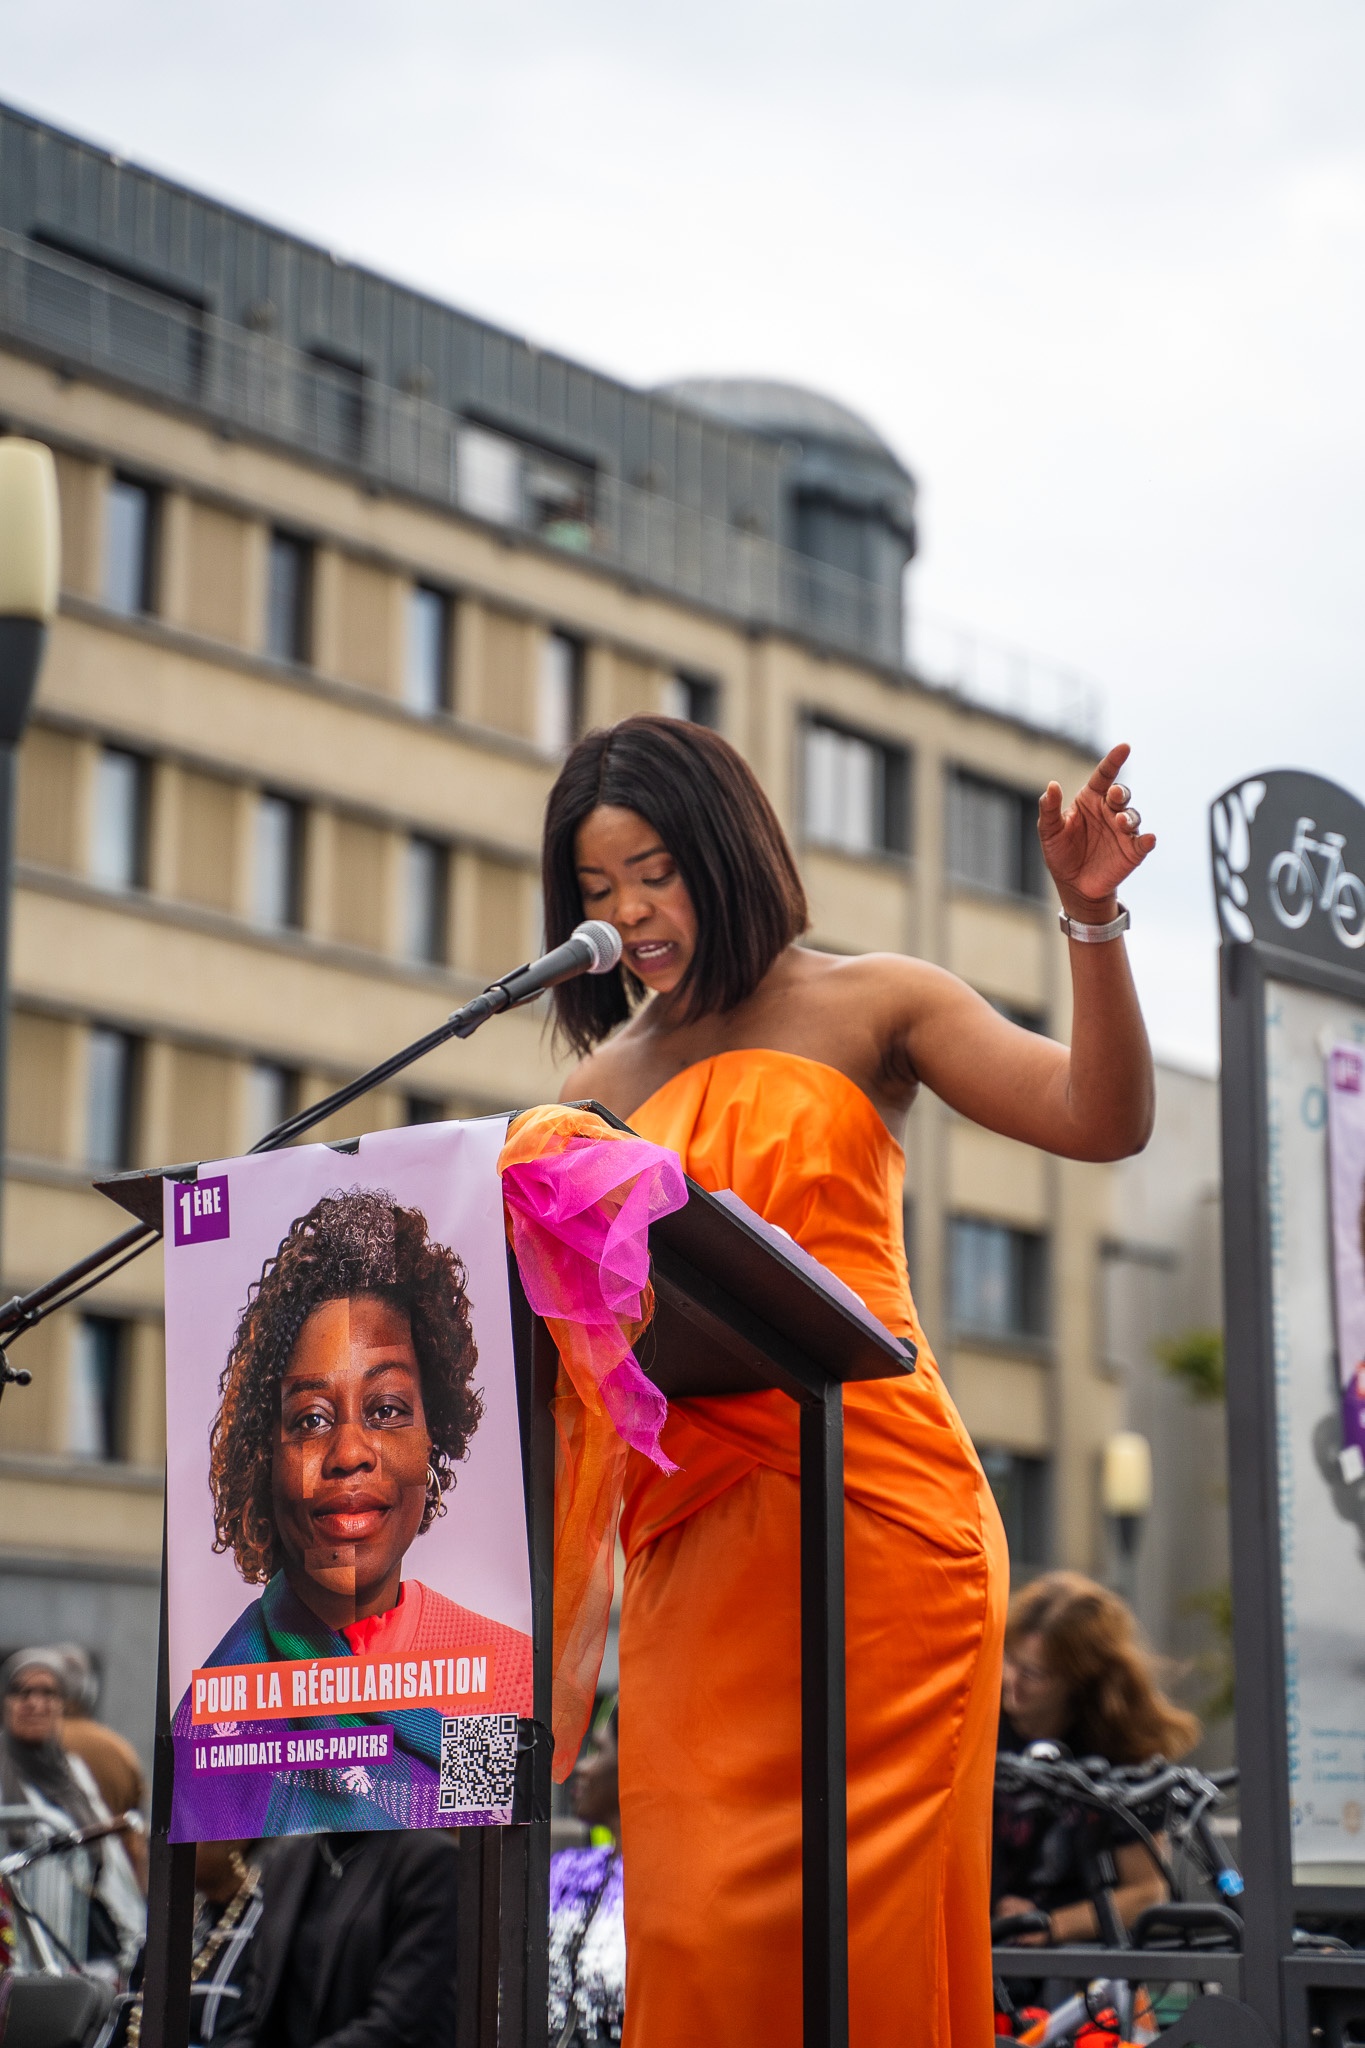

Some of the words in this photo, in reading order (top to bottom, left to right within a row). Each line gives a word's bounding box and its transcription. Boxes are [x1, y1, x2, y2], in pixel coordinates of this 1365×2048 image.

[195, 1675, 247, 1714] POUR
[256, 1672, 282, 1709] LA
[292, 1657, 487, 1707] RÉGULARISATION
[195, 1746, 207, 1769] LA
[210, 1741, 282, 1768] CANDIDATE
[287, 1734, 388, 1762] SANS-PAPIERS
